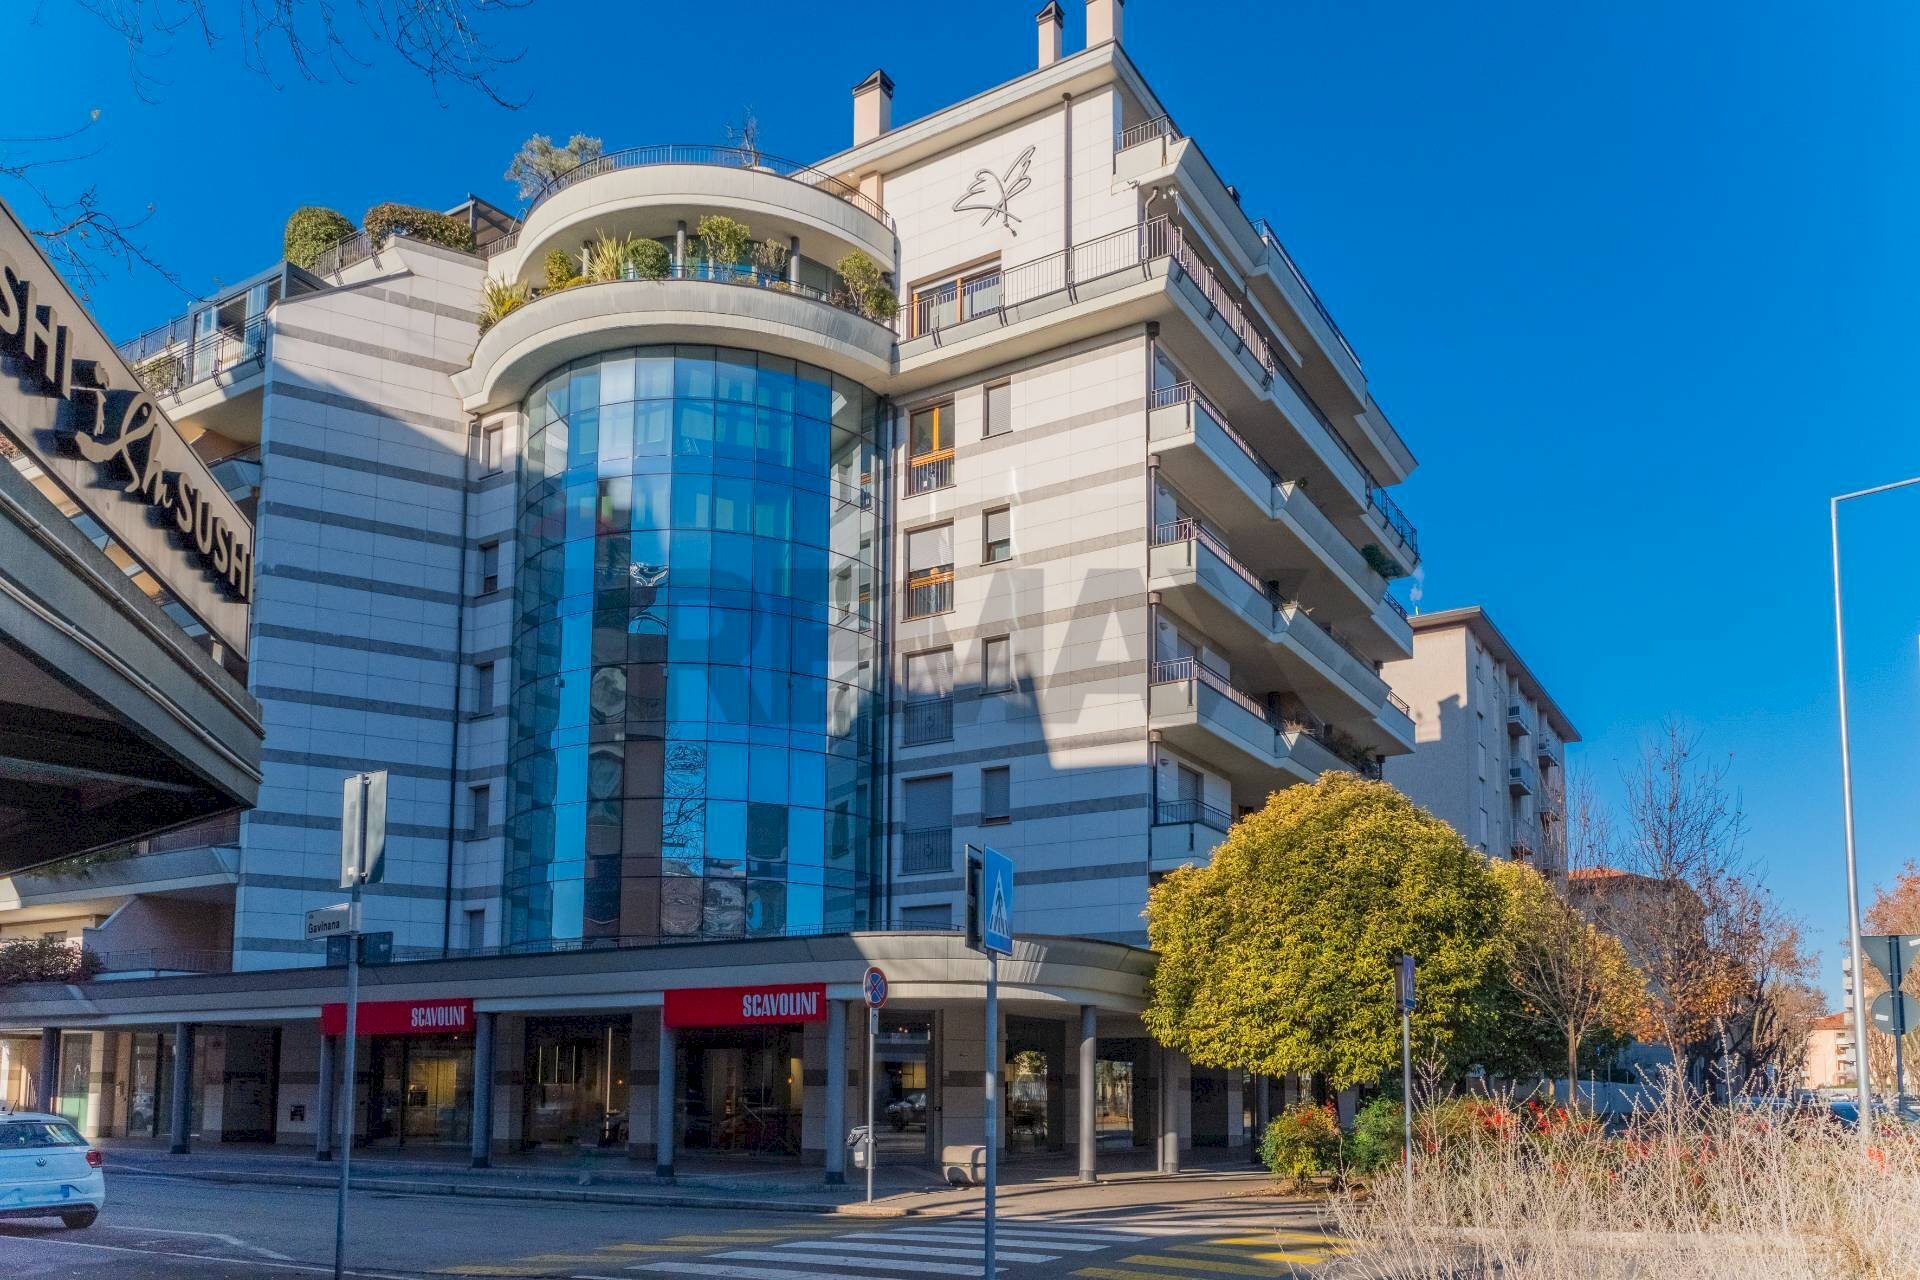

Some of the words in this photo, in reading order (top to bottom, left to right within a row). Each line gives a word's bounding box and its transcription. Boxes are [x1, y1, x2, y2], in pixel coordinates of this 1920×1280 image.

[308, 920, 341, 935] Gavinana
[742, 991, 817, 1018] SCAVOLINI
[411, 1005, 465, 1027] SCAVOLINI
